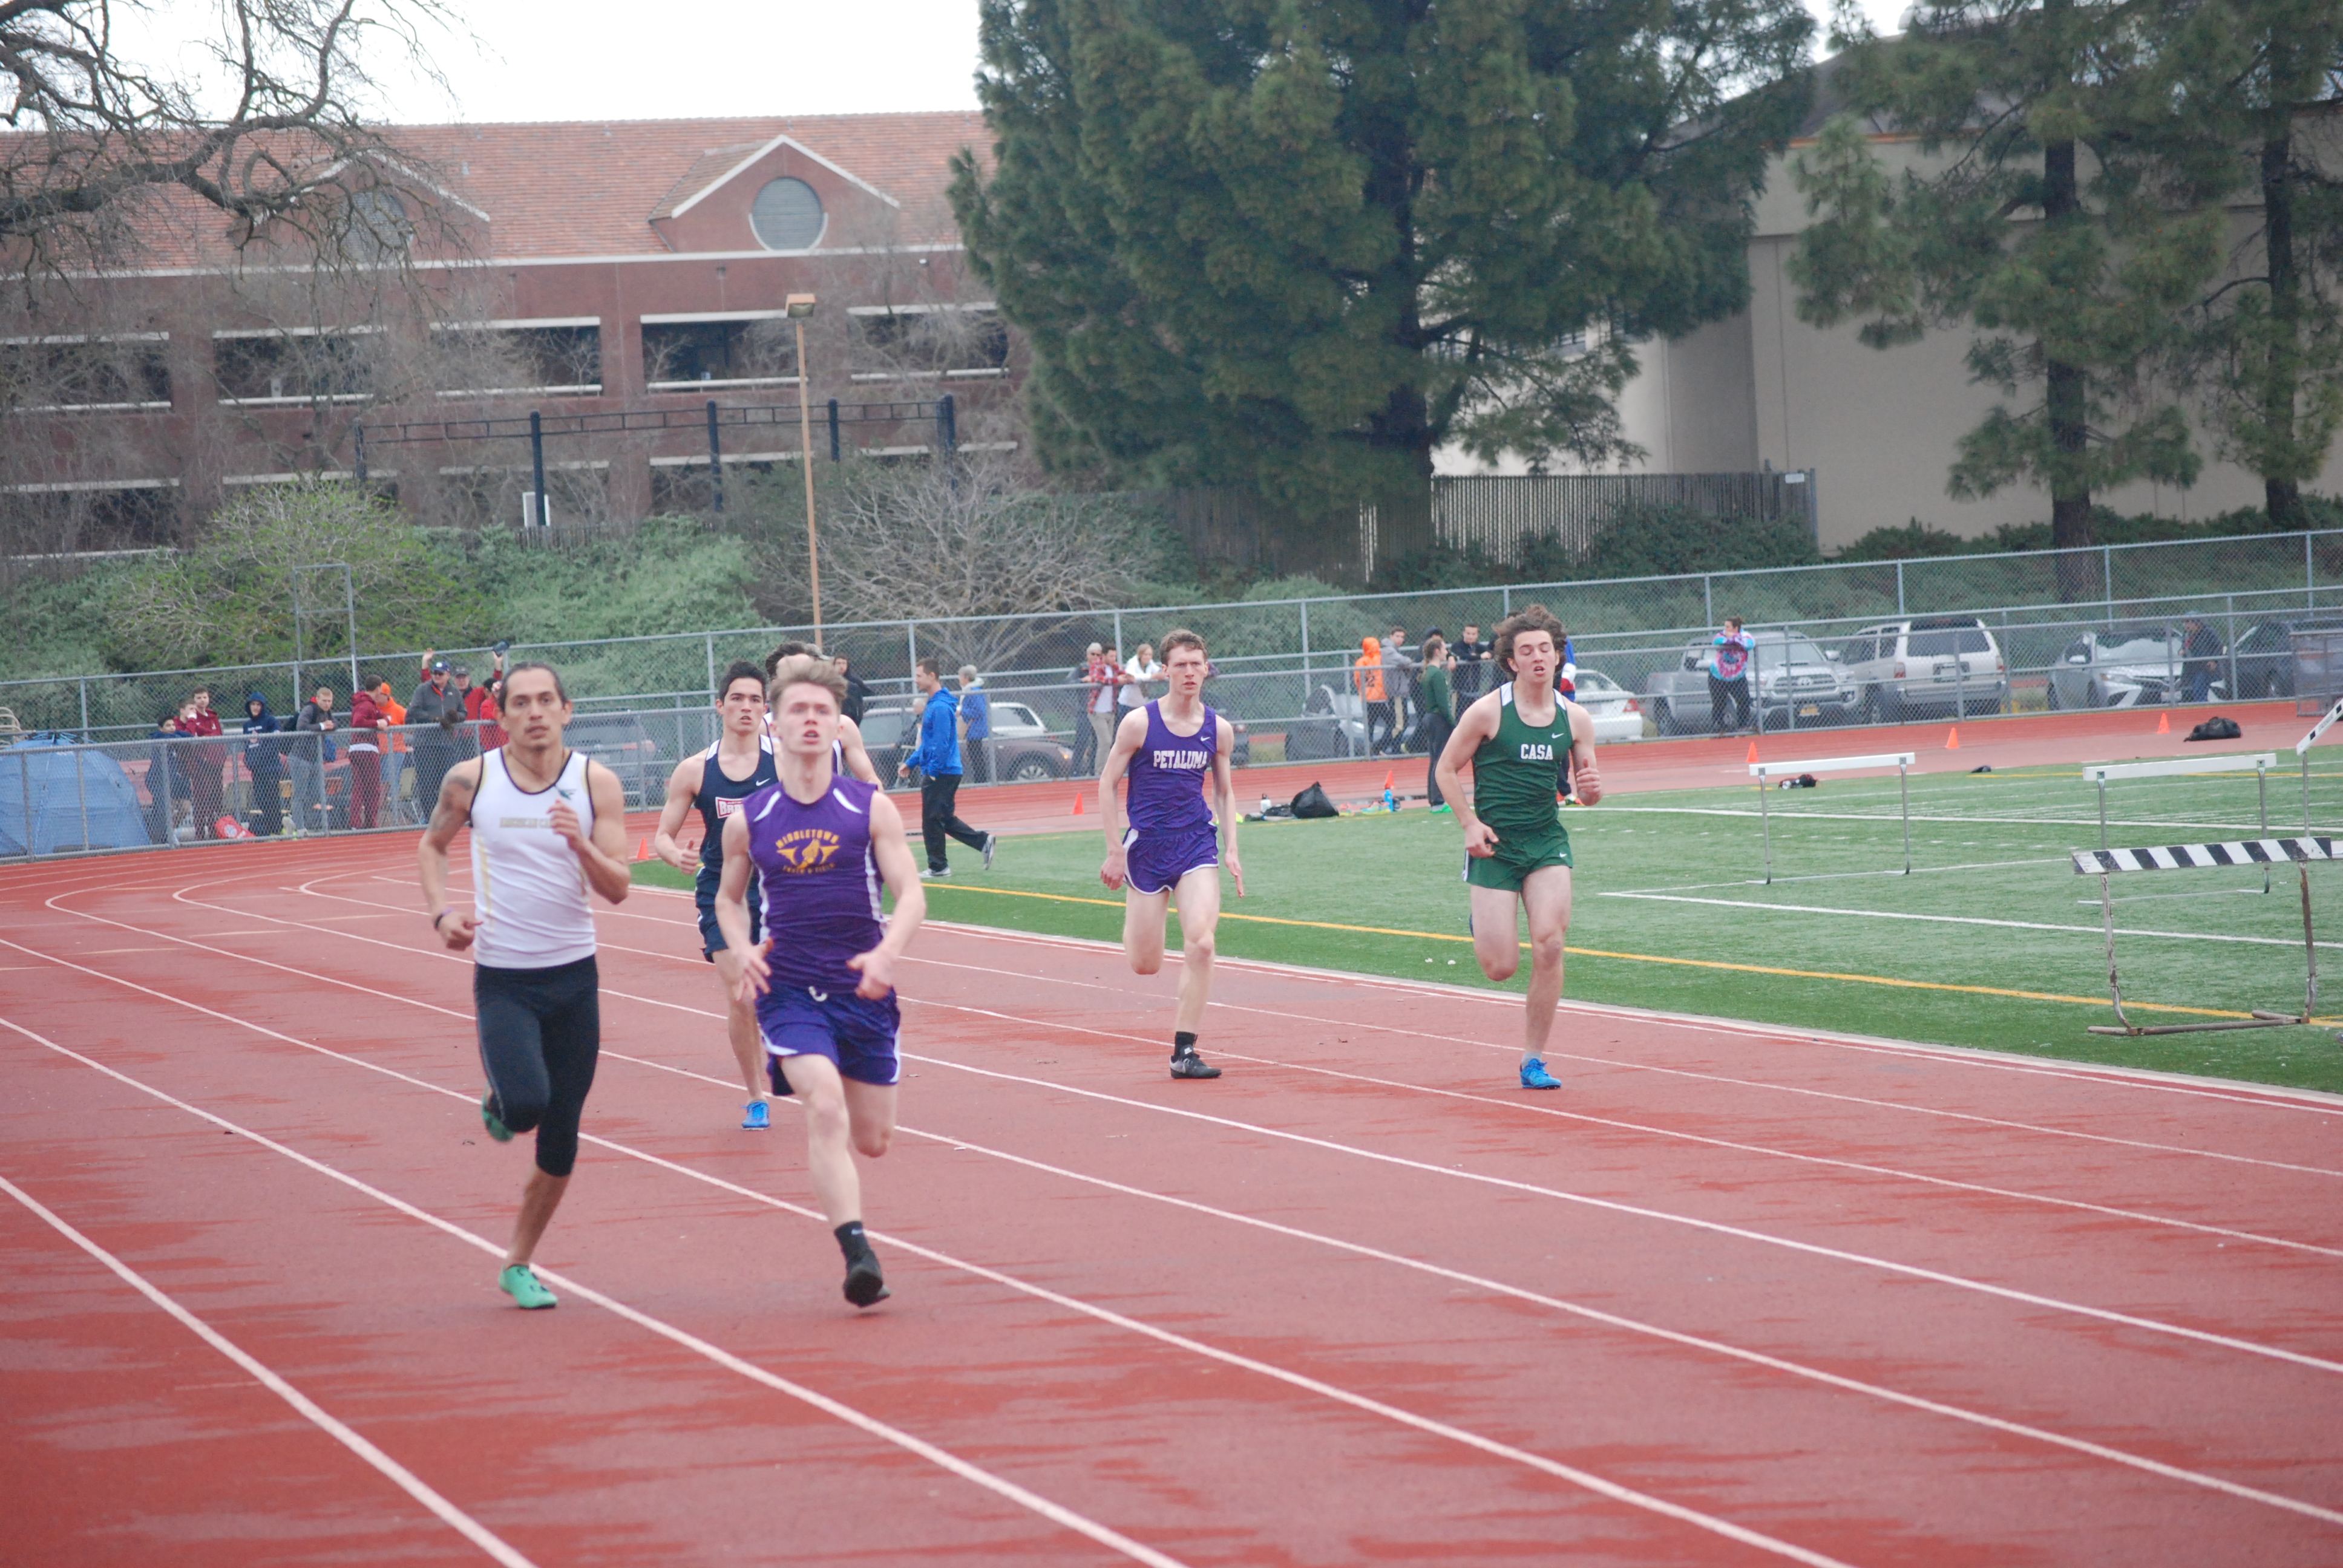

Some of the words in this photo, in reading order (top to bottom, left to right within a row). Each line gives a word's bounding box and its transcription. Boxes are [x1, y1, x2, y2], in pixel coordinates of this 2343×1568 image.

[1153, 750, 1207, 769] PETALUMA
[1520, 743, 1553, 760] CASA
[718, 800, 744, 815] BRA
[775, 829, 840, 849] MIDDLETOWN
